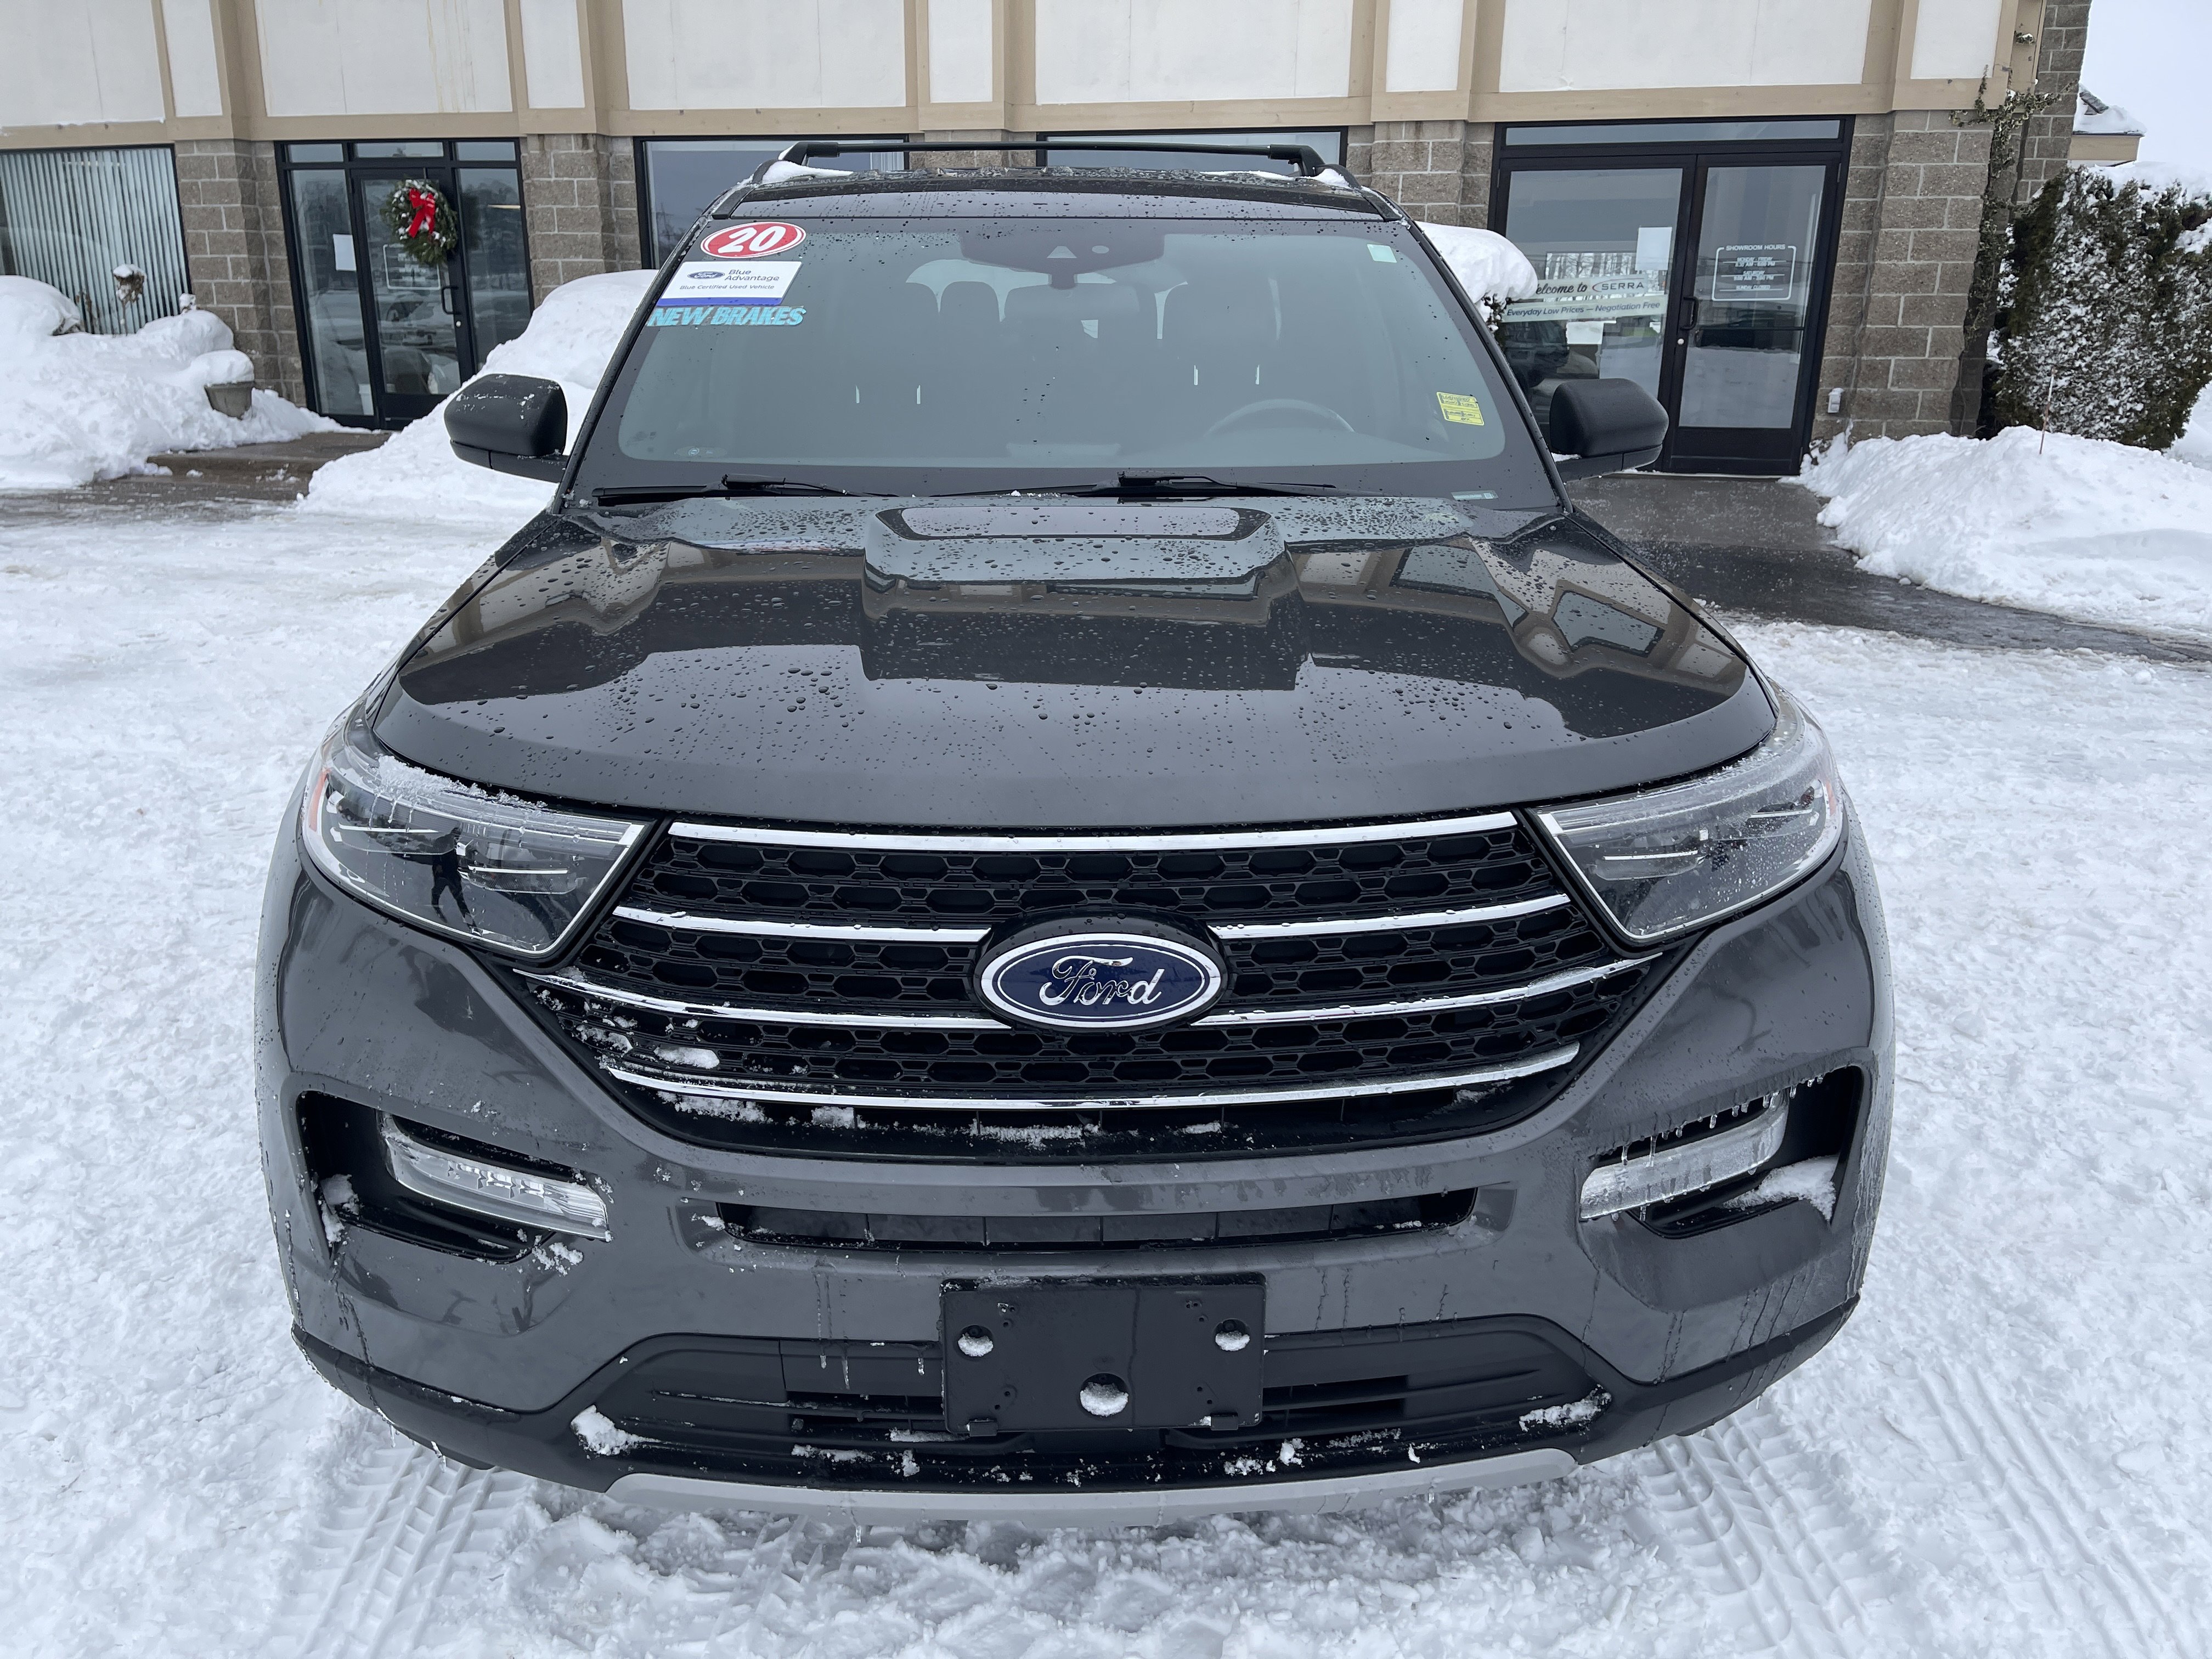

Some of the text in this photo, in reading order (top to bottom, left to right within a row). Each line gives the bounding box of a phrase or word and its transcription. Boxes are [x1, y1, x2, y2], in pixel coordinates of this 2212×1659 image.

[718, 225, 787, 253] 20
[1536, 281, 1645, 295] elcome to SERRA
[647, 307, 807, 326] NEW BRAKES
[1507, 308, 1542, 317] Everyday
[1595, 303, 1641, 313] Negotiation
[1039, 955, 1165, 1006] Ford
